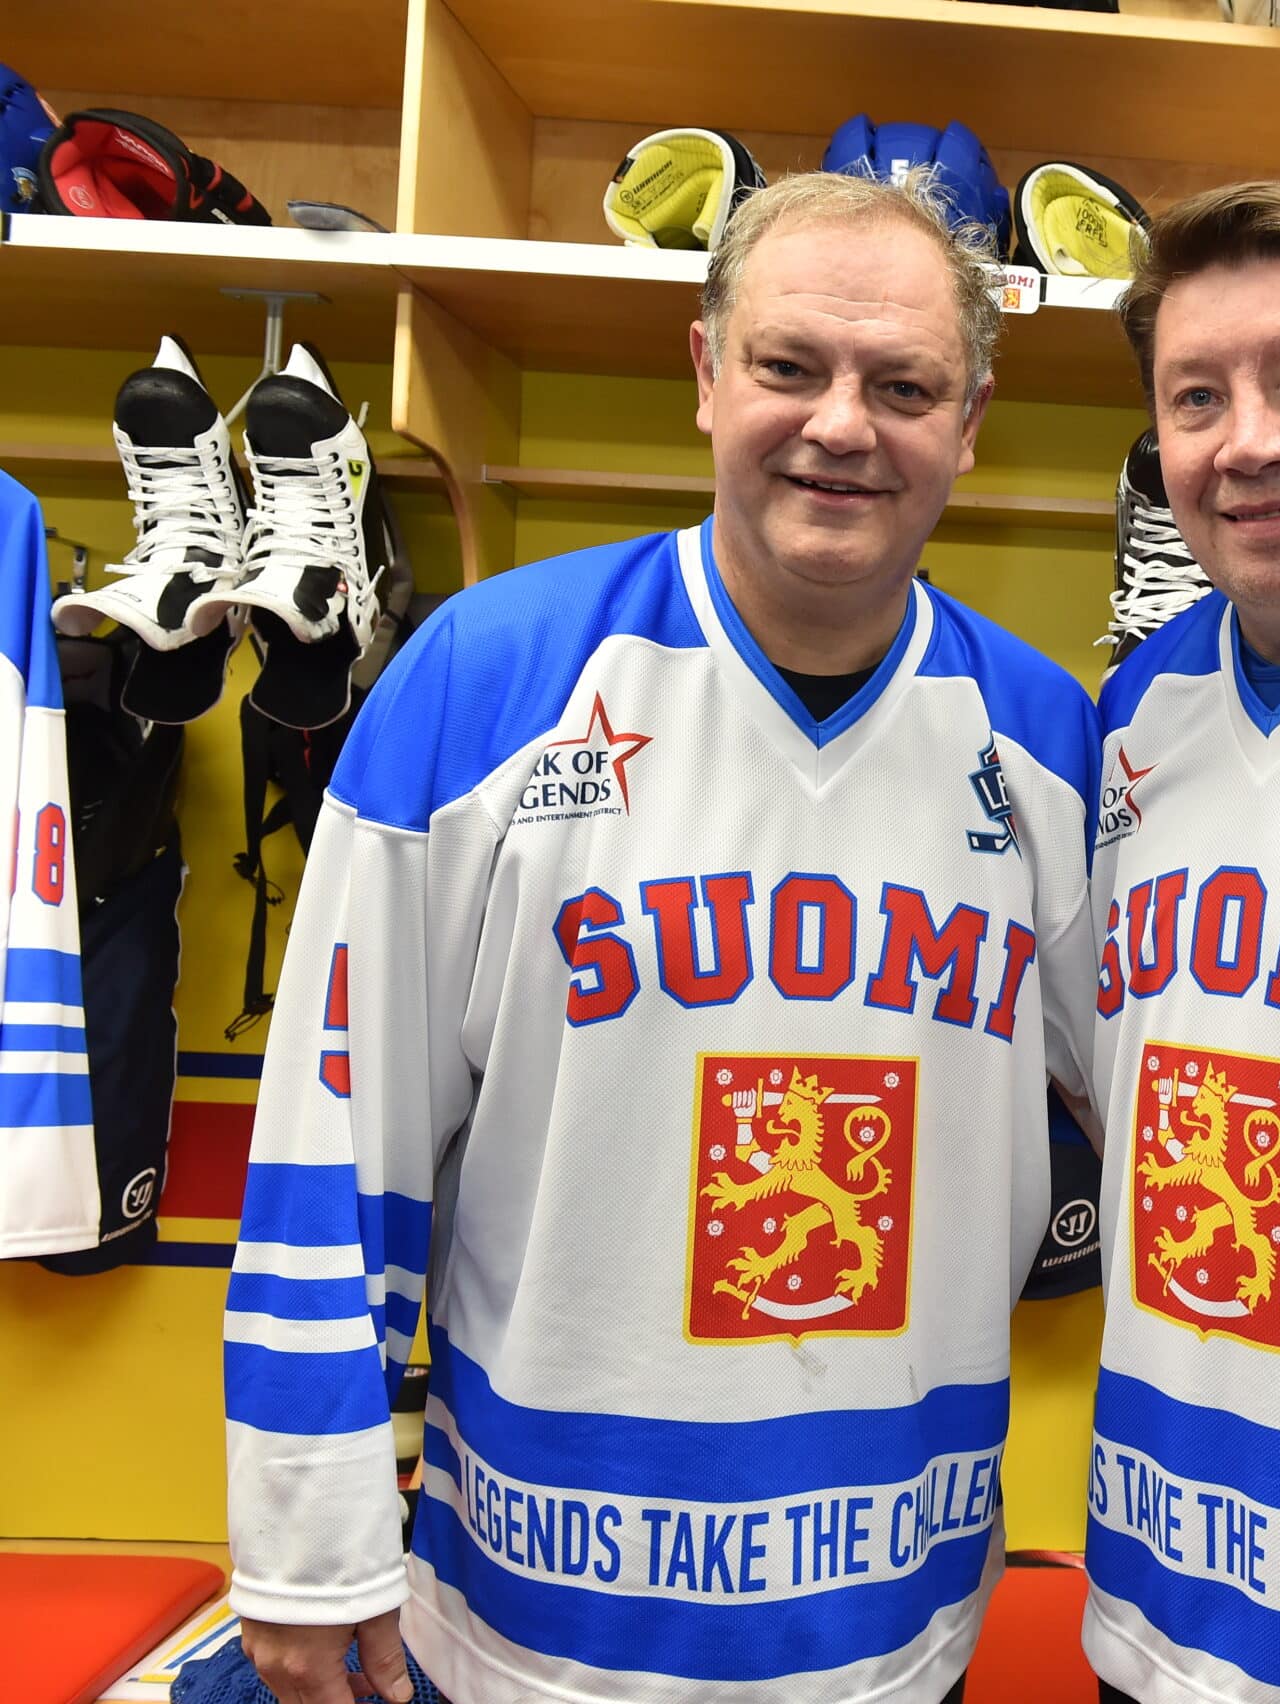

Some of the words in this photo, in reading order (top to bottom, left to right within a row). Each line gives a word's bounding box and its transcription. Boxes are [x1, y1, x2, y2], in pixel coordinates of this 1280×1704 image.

[516, 816, 534, 825] AND
[571, 750, 609, 775] OF
[31, 801, 66, 907] 8
[552, 871, 1036, 1044] SUOMI
[466, 1454, 622, 1583] LEGENDS
[641, 1508, 769, 1594] TAKE
[785, 1497, 873, 1586] THE
[1116, 1454, 1183, 1563] TAKE
[1197, 1492, 1268, 1595] THE
